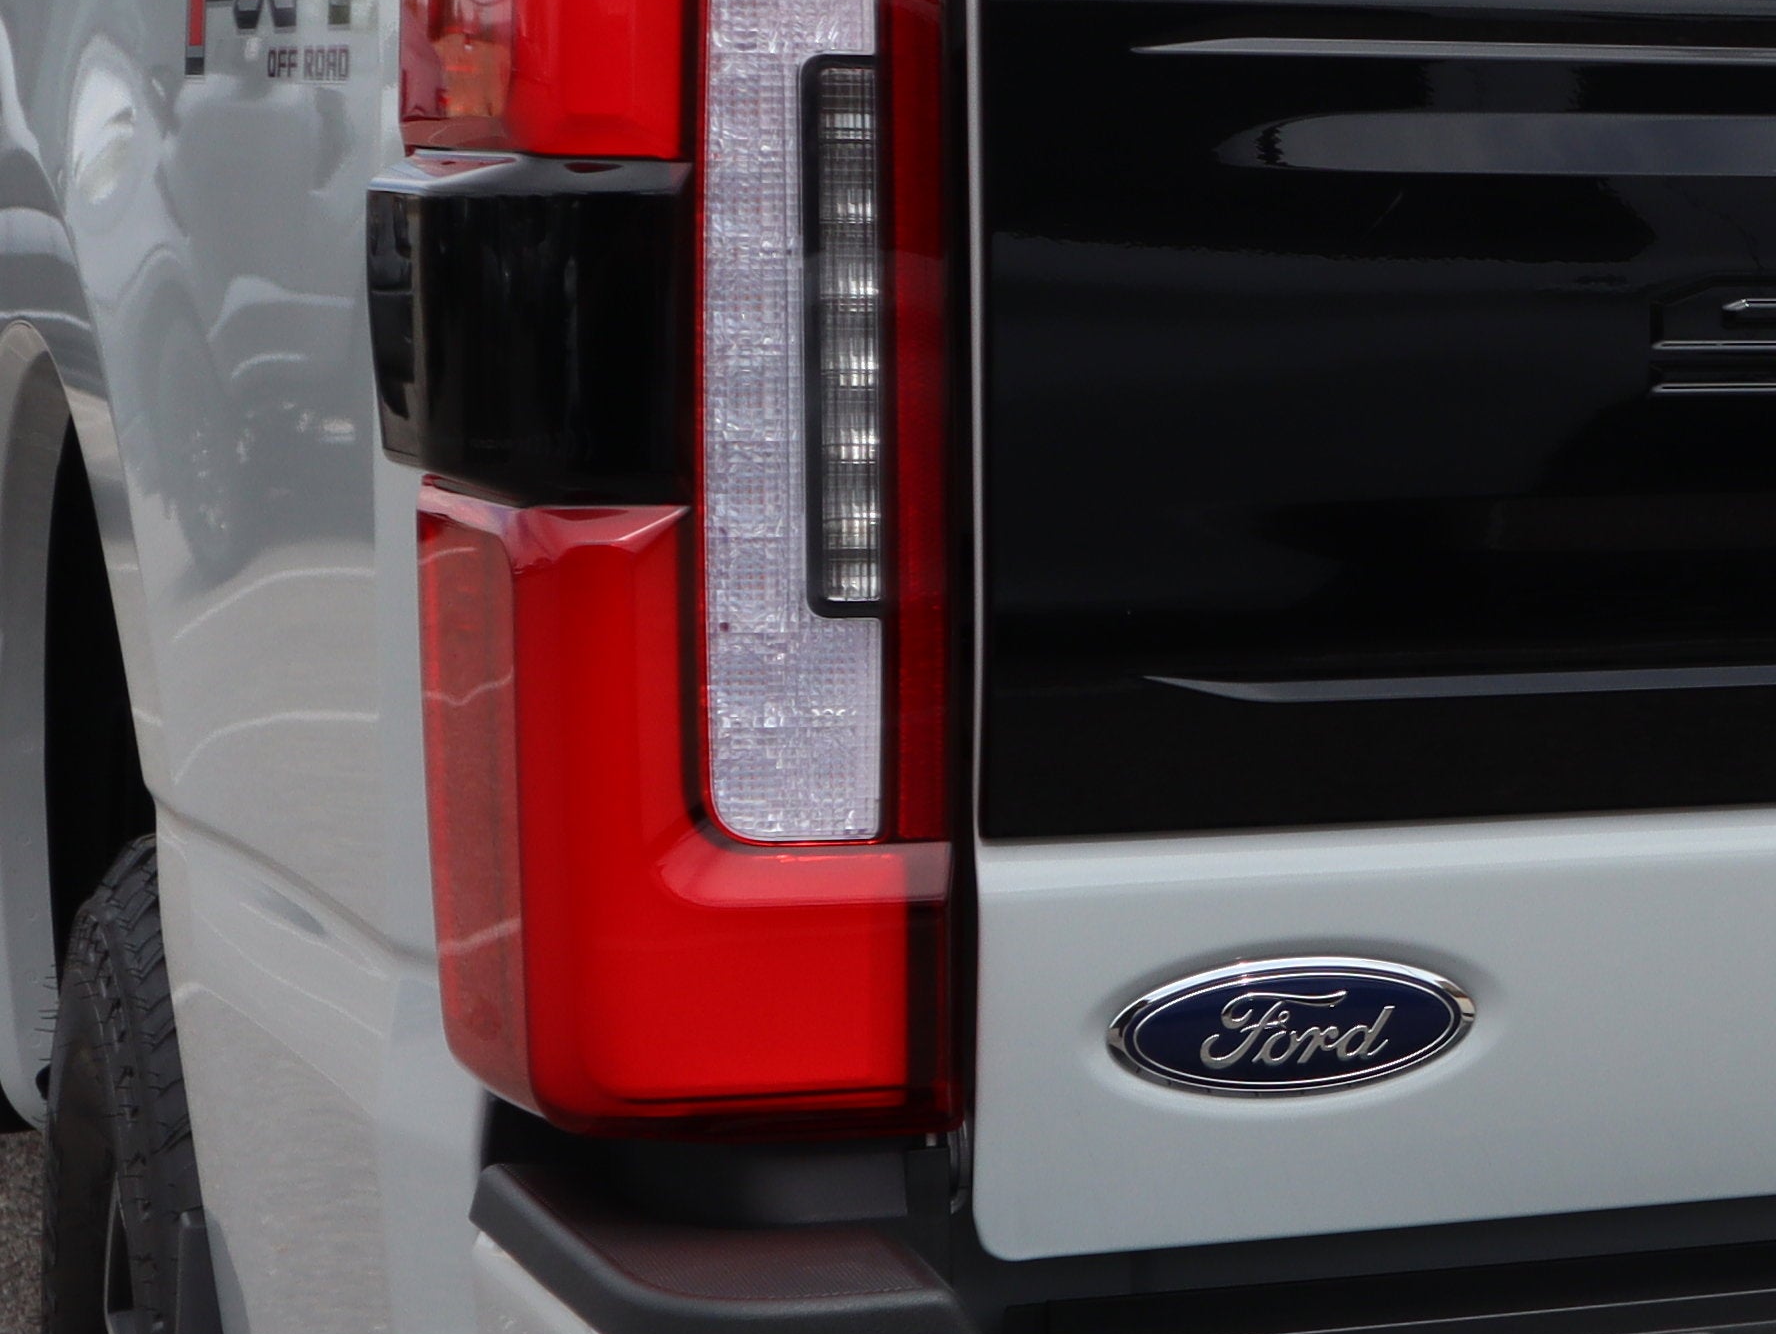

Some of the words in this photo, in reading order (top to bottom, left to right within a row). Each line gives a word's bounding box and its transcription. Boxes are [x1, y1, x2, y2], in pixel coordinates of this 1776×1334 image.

[267, 48, 298, 79] OFF
[303, 45, 349, 80] ROAD
[1199, 990, 1396, 1070] Ford
